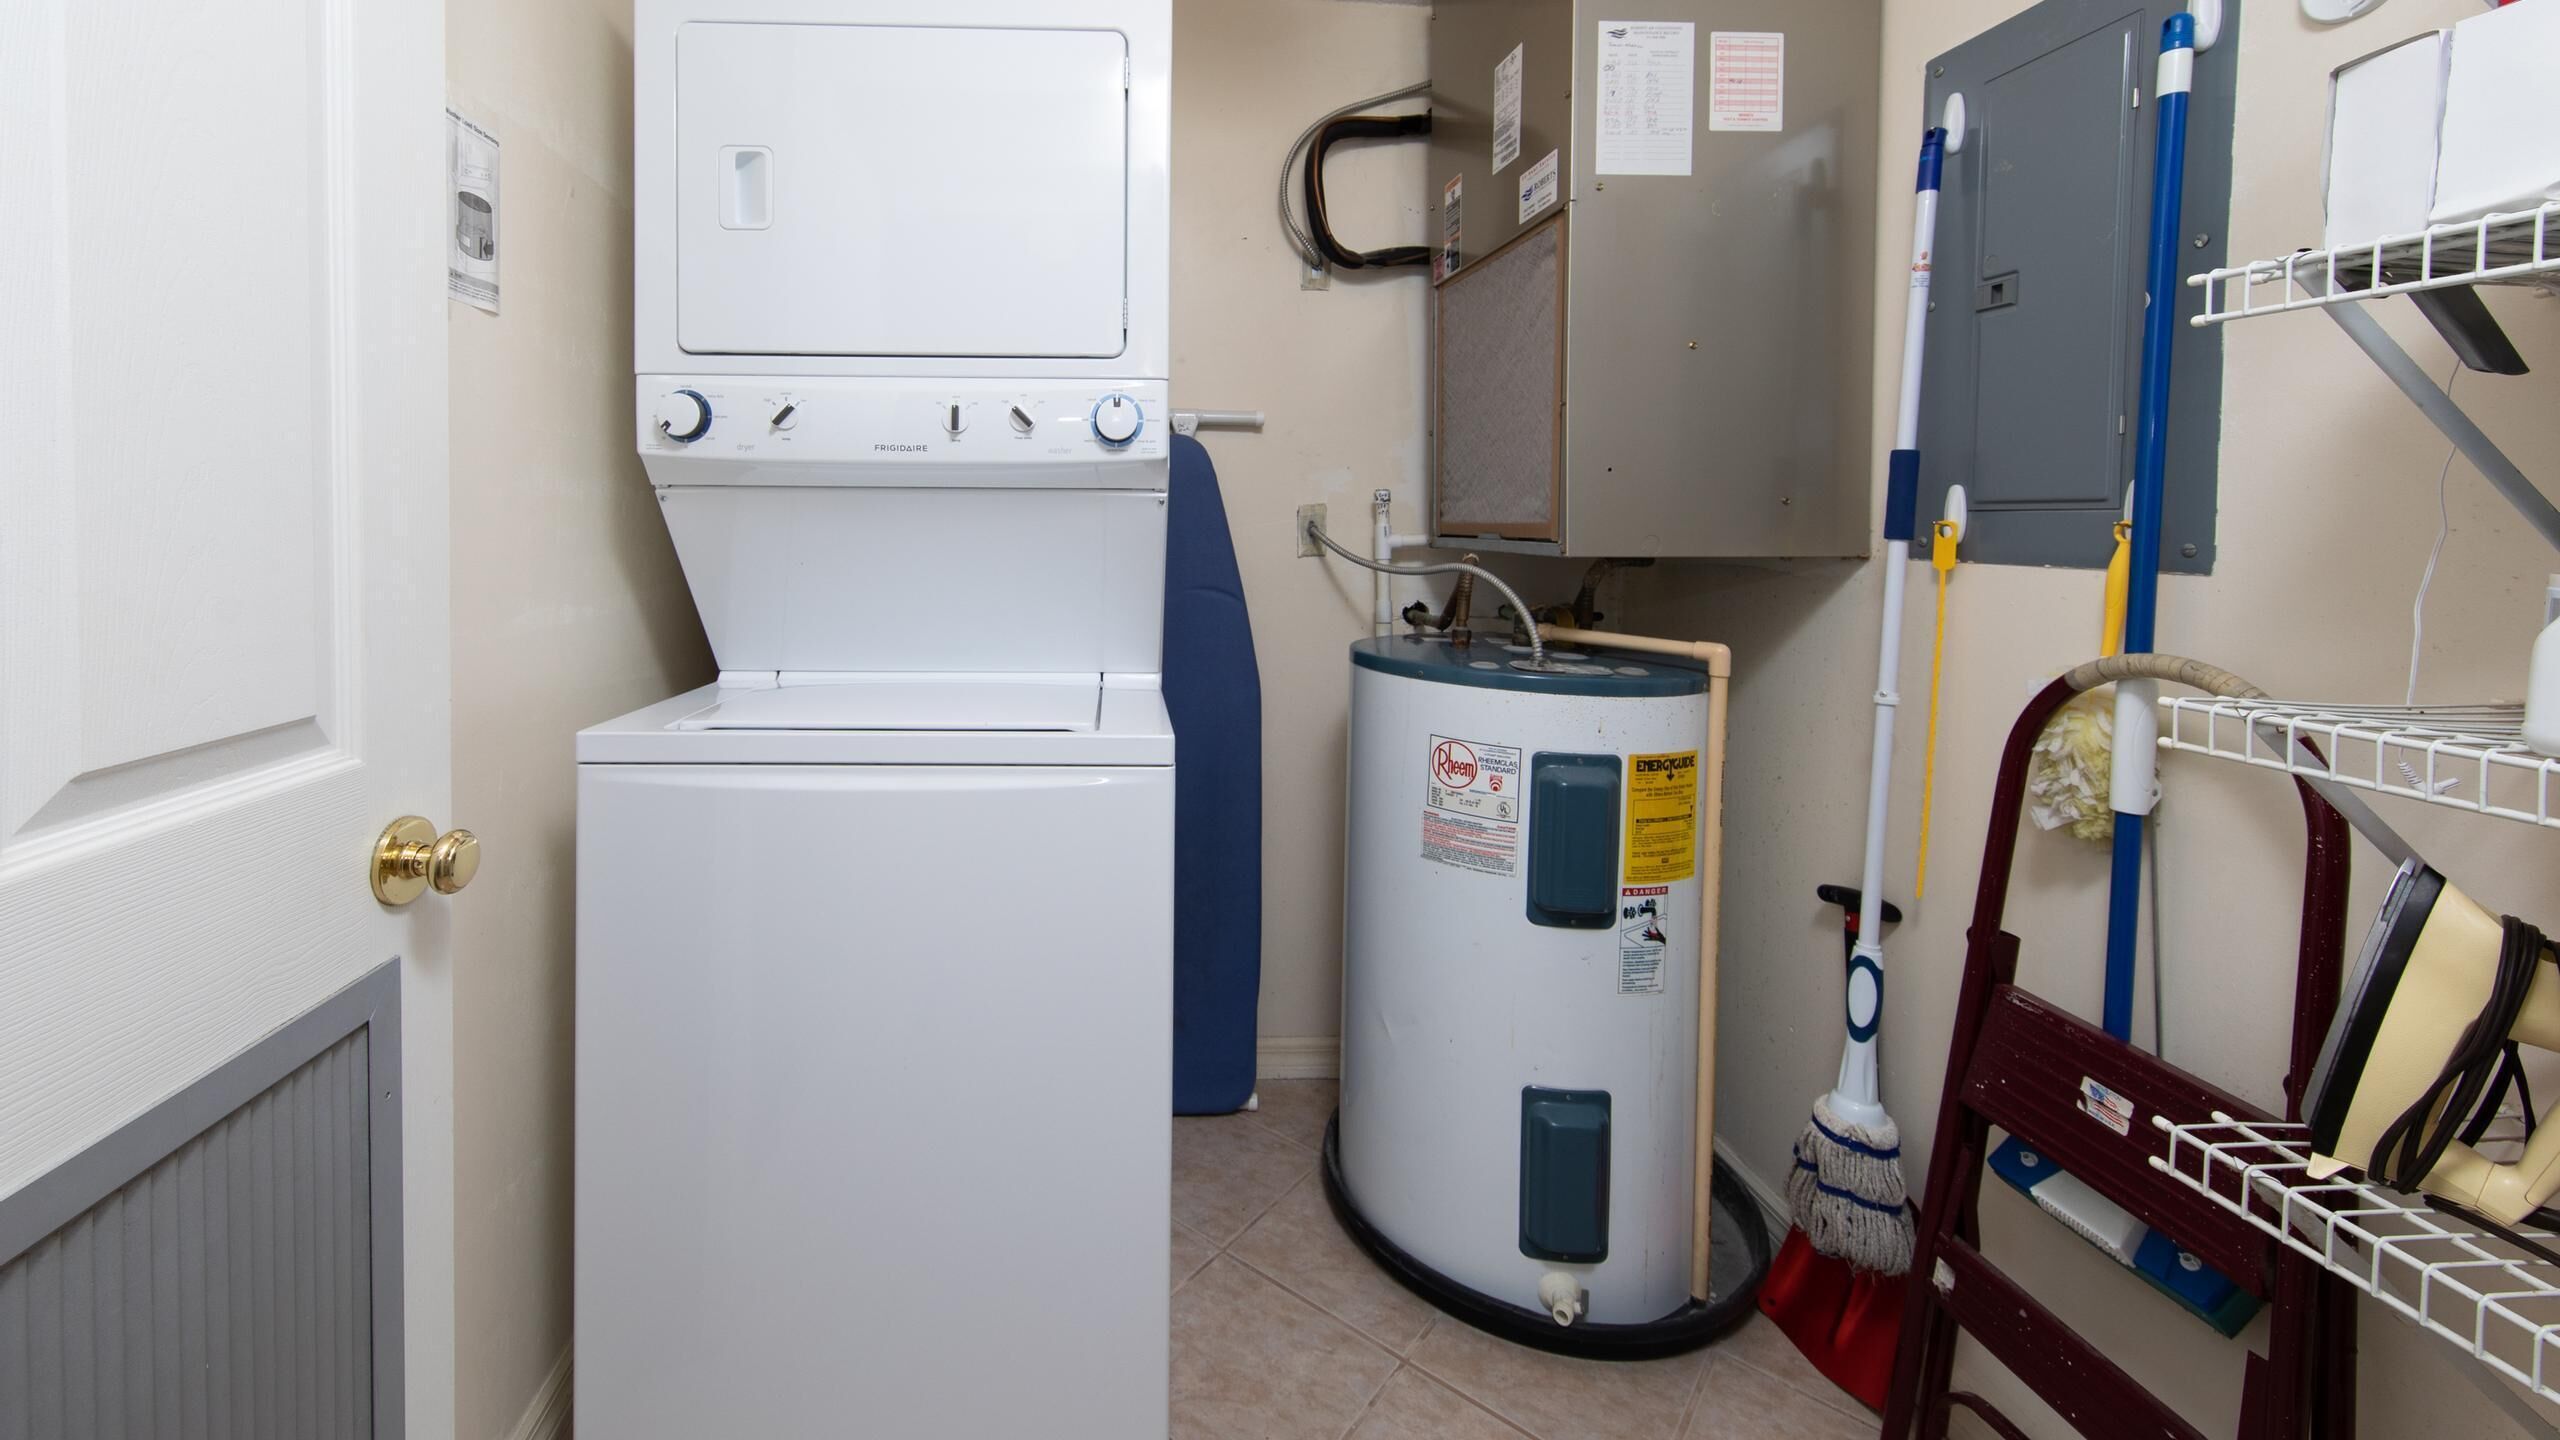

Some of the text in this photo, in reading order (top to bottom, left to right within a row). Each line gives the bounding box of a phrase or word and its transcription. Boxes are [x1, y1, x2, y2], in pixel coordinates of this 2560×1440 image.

[1534, 169, 1556, 189] ROBERTS
[736, 442, 755, 453] dryer
[874, 444, 928, 452] FRIGIDAIRE
[1048, 446, 1072, 454] washer
[1437, 744, 1474, 780] Rheem
[1480, 764, 1517, 775] STANDARD
[1632, 887, 1667, 896] DANGER
